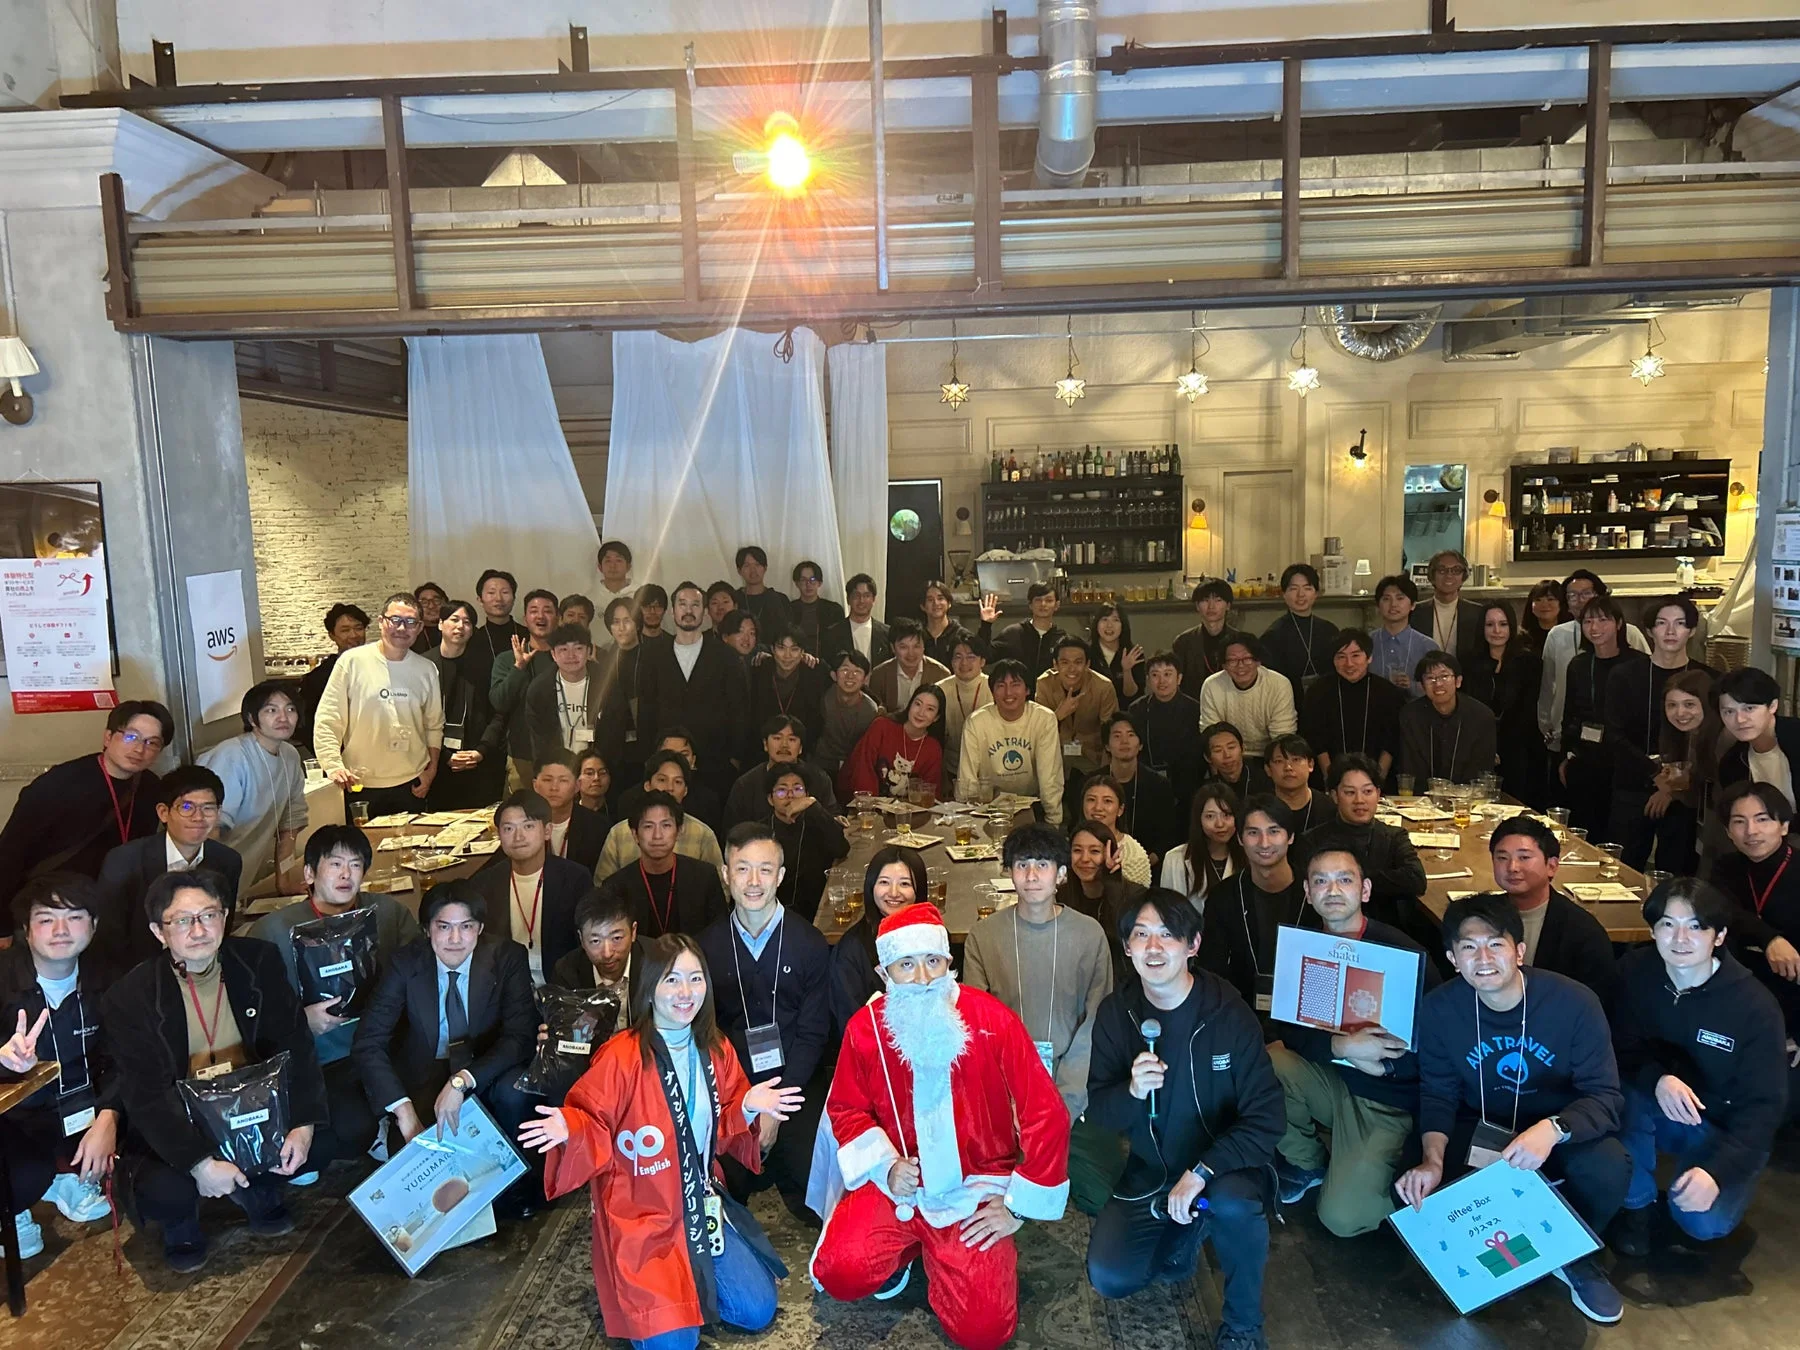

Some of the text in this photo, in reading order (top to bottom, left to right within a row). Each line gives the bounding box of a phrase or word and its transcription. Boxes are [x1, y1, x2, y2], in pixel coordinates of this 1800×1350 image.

[207, 626, 235, 648] aws
[1328, 949, 1360, 963] shakti
[1466, 1036, 1555, 1070] AVA TRAVEL
[639, 1157, 671, 1176] English
[1473, 1196, 1491, 1208] Box
[1469, 1217, 1501, 1237] クリスマス
